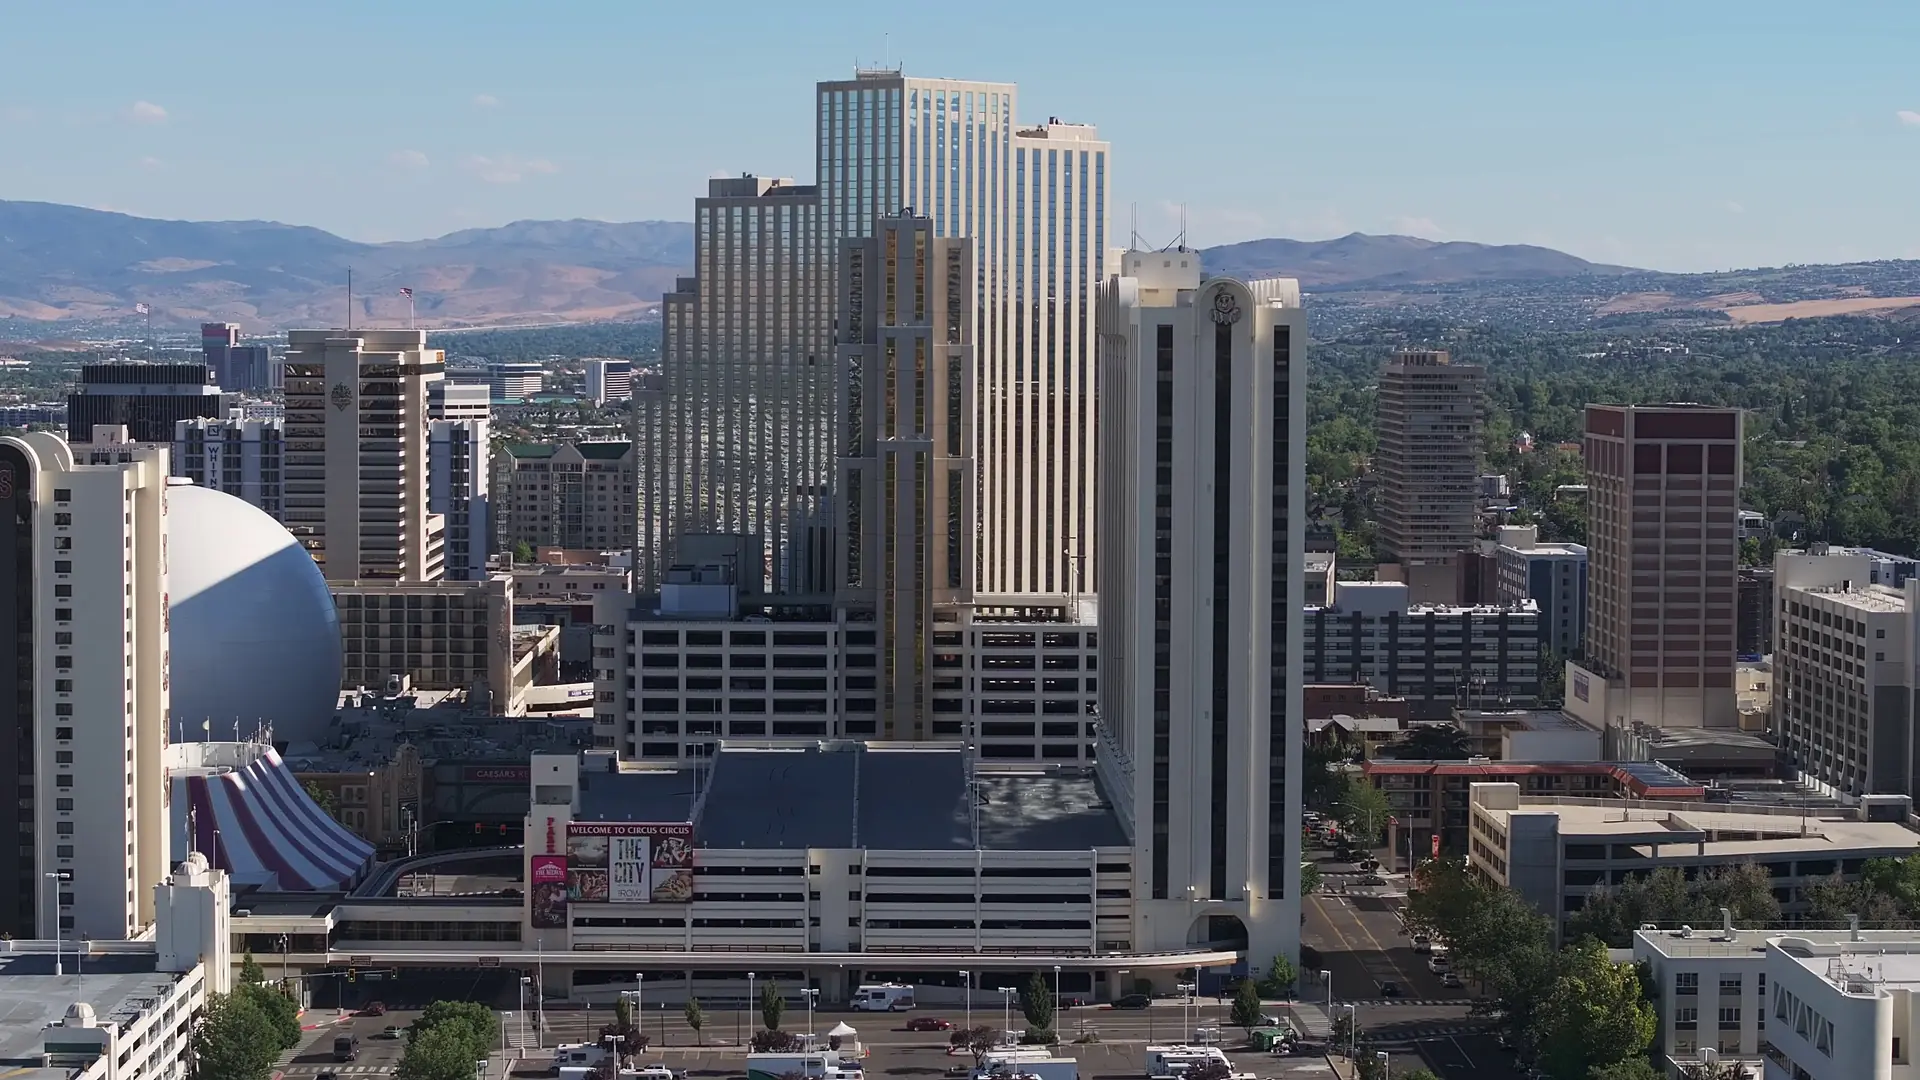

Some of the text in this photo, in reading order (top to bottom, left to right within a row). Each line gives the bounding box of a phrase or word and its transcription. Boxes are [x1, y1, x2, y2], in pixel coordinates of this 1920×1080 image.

[477, 770, 515, 778] CAESARS
[570, 826, 689, 834] WELCOME TO CIRCUS CIRCUS
[616, 838, 642, 860] THE
[614, 862, 645, 883] CITY
[621, 889, 642, 897] ROW
